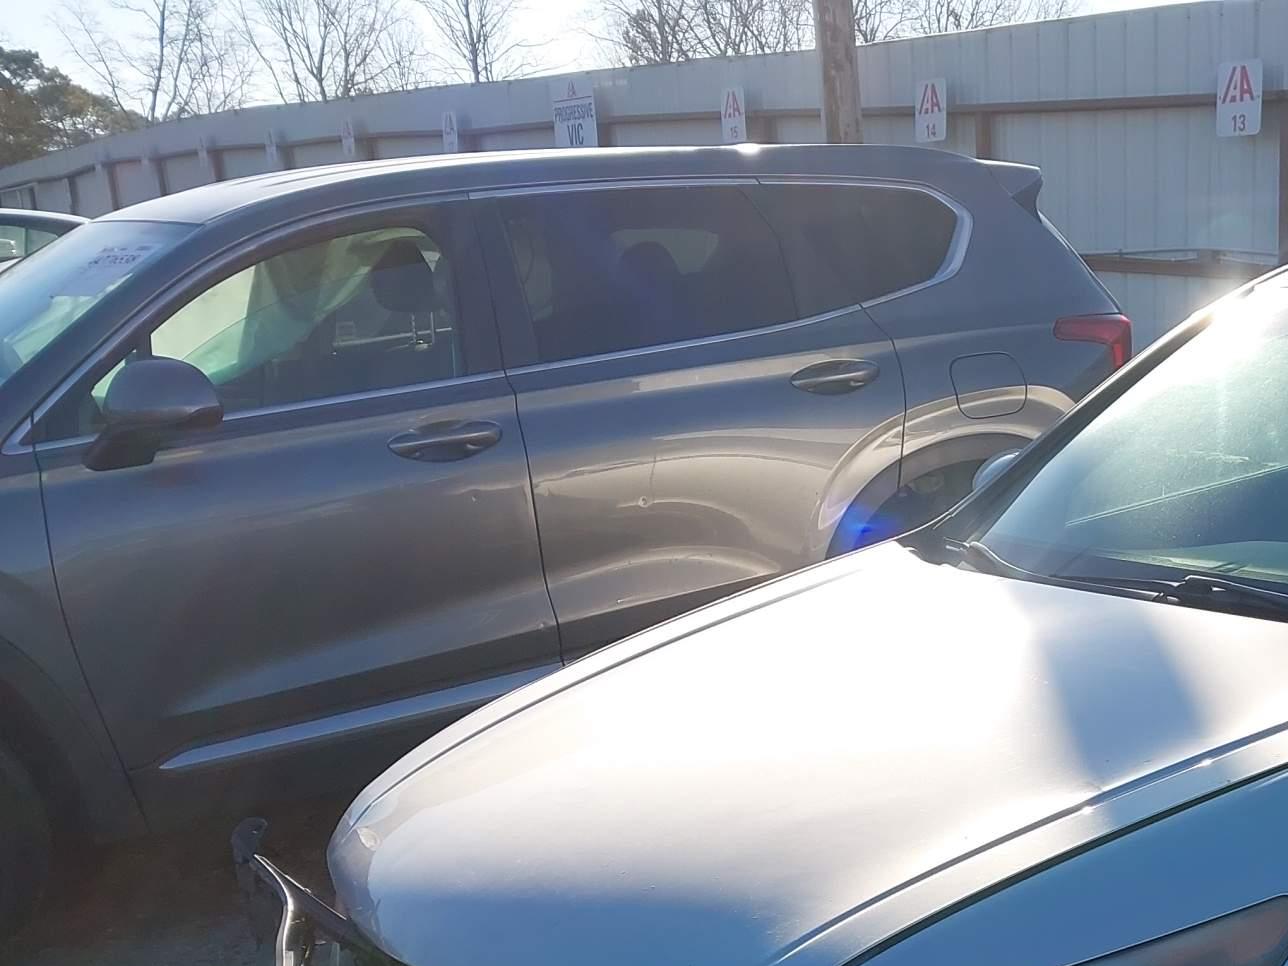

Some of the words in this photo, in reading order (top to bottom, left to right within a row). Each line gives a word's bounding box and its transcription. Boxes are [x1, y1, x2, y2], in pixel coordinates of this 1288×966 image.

[554, 102, 593, 121] PROGRESSIVE
[926, 123, 936, 138] 14
[1232, 114, 1246, 132] 13
[567, 123, 584, 146] VIC
